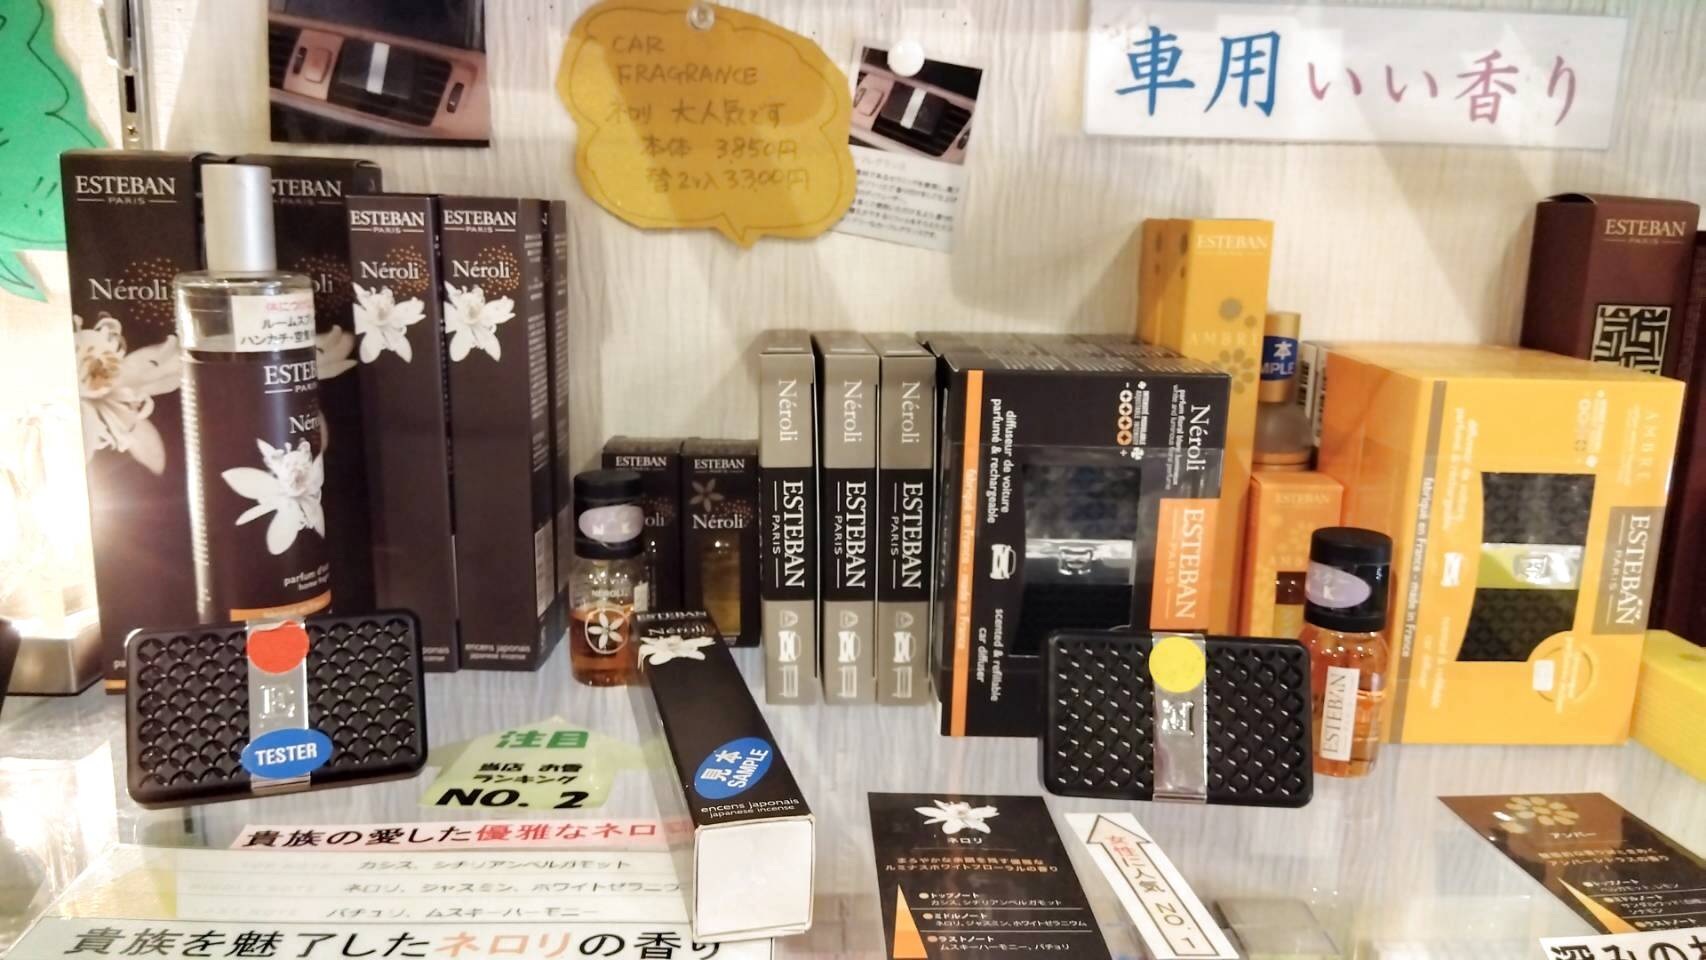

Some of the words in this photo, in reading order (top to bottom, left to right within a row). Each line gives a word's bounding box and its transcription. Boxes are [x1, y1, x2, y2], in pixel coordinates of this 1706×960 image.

[612, 36, 665, 54] CAR
[618, 63, 758, 85] FRAGRANCE
[75, 175, 175, 196] ESTEBAN
[350, 210, 425, 226] ESTEBAN
[443, 209, 517, 226] ESTEBAN
[1604, 219, 1687, 237] ESTEBAN
[373, 226, 401, 234] PARIS
[465, 226, 493, 234] PARIS
[1197, 234, 1268, 249] ESTEBAN
[360, 260, 419, 280] Néroli
[452, 260, 510, 279] Néroli
[88, 277, 169, 301] Néroli
[778, 379, 798, 442] Néroli
[843, 380, 863, 443] Néroli
[901, 381, 921, 444] Néroli
[990, 398, 1003, 443] parfumé
[1003, 410, 1017, 457] diffuseur
[1186, 404, 1211, 472] Néroli
[615, 456, 668, 467] ESTEBAN
[694, 459, 745, 470] ESTEBAN
[1003, 459, 1014, 473] de
[986, 457, 1000, 524] rechargeable
[1000, 475, 1012, 514] voiture
[1416, 476, 1435, 521] fabriqué
[692, 514, 744, 529] Néroli
[1416, 522, 1427, 536] en
[772, 514, 781, 554] PARIS
[783, 480, 805, 588] ESTEBAN
[834, 515, 843, 555] PARIS
[846, 481, 867, 588] ESTEBAN
[890, 516, 899, 556] PARIS
[902, 482, 923, 589] ESTEBAN
[1174, 507, 1205, 620] ESTEBAN
[1411, 537, 1428, 572] France
[1614, 513, 1651, 625] ESTEBAN
[1407, 581, 1420, 610] made
[636, 610, 707, 622] ESTEBAN
[978, 627, 988, 644] car
[993, 608, 1005, 648] scented
[1402, 623, 1416, 658] France
[976, 645, 987, 683] diffuser
[990, 660, 1002, 702] refillable
[1324, 673, 1347, 755] ESTEBAN
[496, 730, 589, 749] 注目
[254, 742, 318, 766] TESTER
[478, 762, 525, 772] 当店
[700, 750, 743, 782] 見本
[727, 748, 769, 789] SAMPLE
[473, 774, 580, 785] ランキング
[435, 788, 530, 808] NO.
[553, 791, 590, 809] 2
[701, 803, 745, 813] encens
[749, 797, 800, 809] japonais
[710, 808, 754, 818] japanese
[757, 804, 795, 813] incense
[242, 824, 690, 847] 貴族の愛した優雅なネロ
[947, 837, 983, 845] ネロリ
[934, 912, 988, 920] ミドルノート
[938, 935, 995, 943] ラストノート
